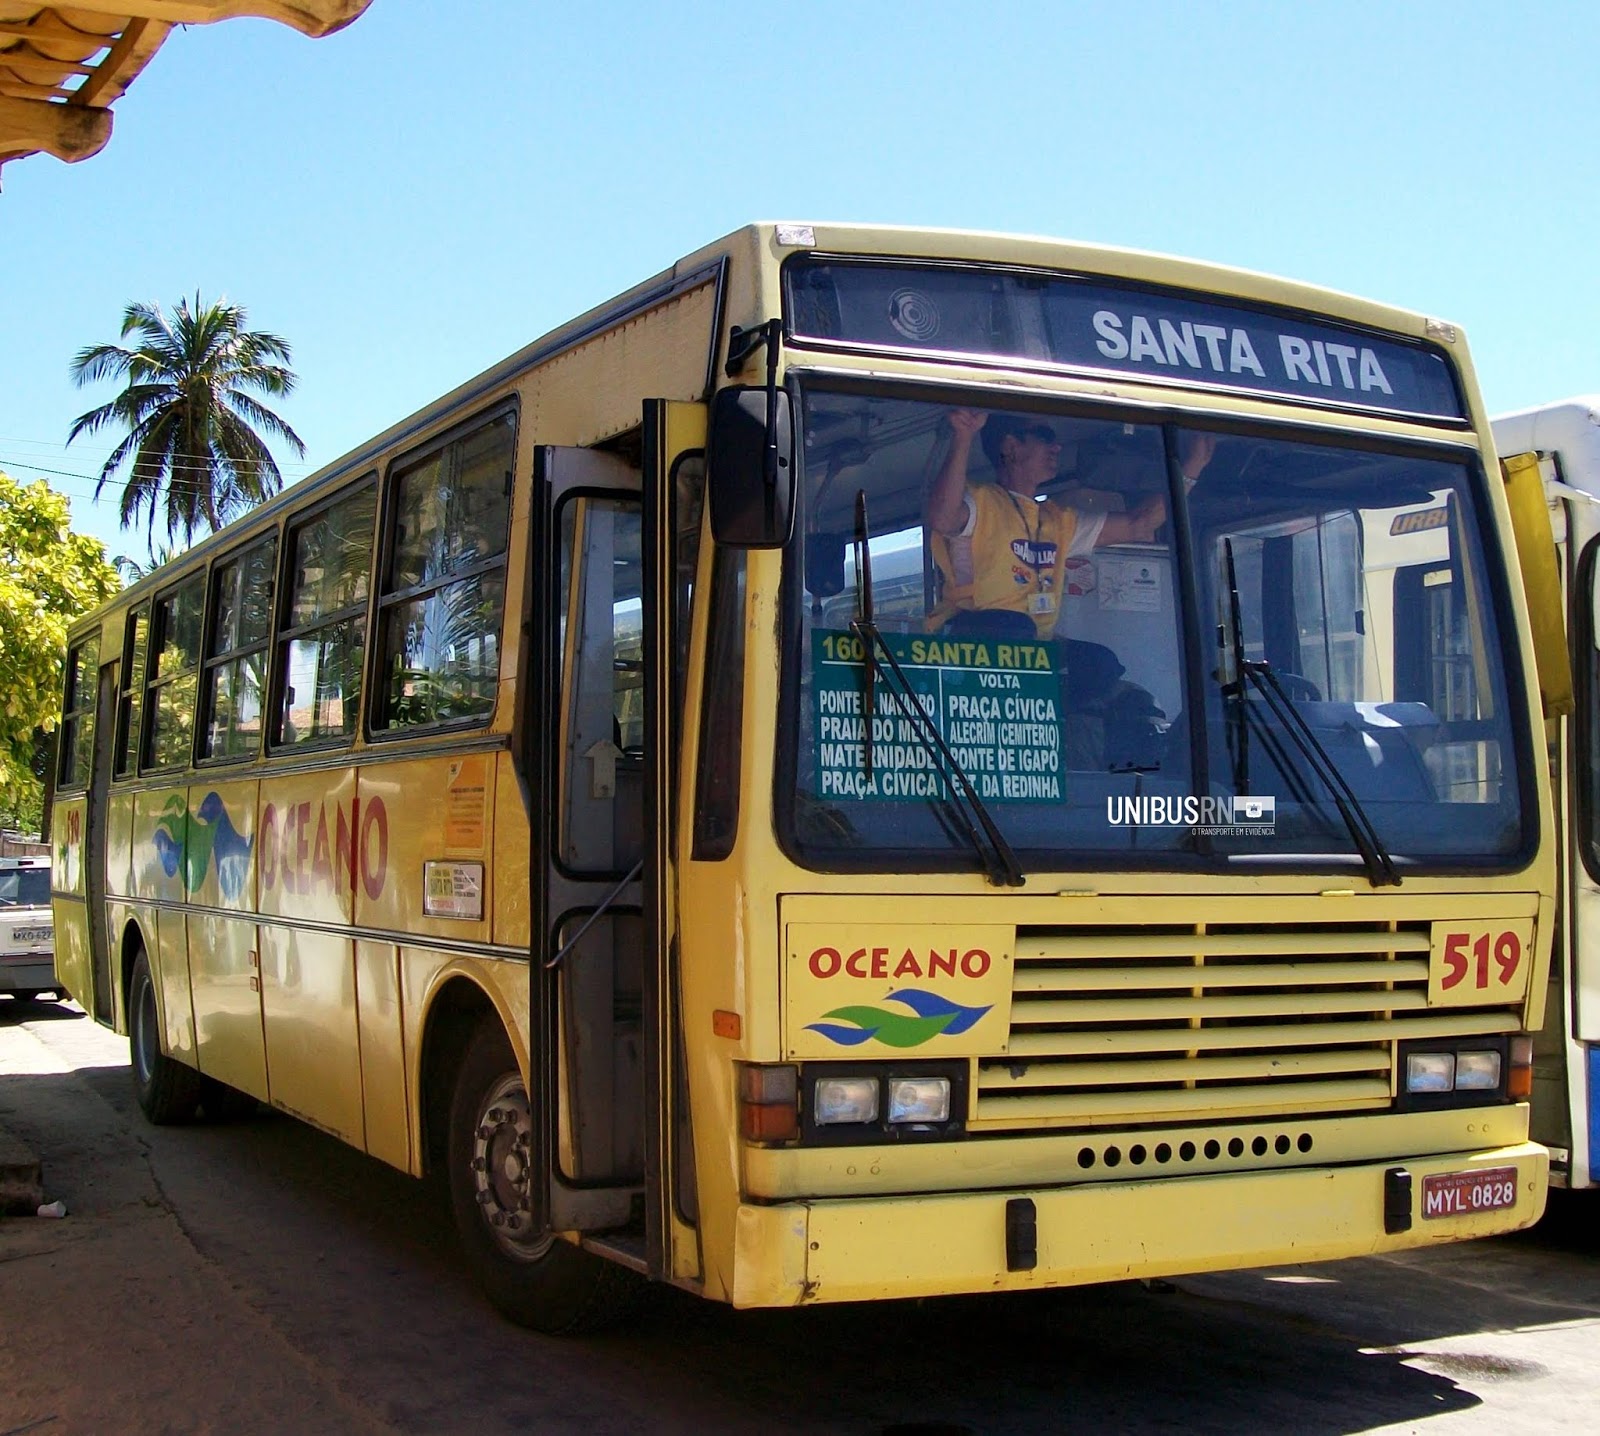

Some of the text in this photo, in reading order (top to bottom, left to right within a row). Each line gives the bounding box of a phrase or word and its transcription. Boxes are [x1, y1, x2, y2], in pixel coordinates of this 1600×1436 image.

[1092, 310, 1394, 395] SANTA RITA
[911, 640, 991, 667] SANTA
[997, 645, 1050, 669] RITA
[979, 673, 1021, 689] VOLTA
[820, 690, 861, 714] PONTE
[948, 693, 1057, 722] PRAÇA CÍVICA
[820, 717, 868, 741] PRAIA
[872, 719, 894, 742] DO
[949, 721, 996, 744] ALECRIM
[949, 747, 995, 771] PONTE
[998, 749, 1015, 771] DE
[821, 766, 939, 800] PRAÇA CÍVICA
[982, 775, 1000, 797] DA
[1003, 775, 1060, 798] REDINHA
[259, 795, 389, 901] OCEANO
[808, 947, 991, 979] OCEANO
[1440, 930, 1521, 991] 519
[1427, 1181, 1514, 1214] MYL 0828
